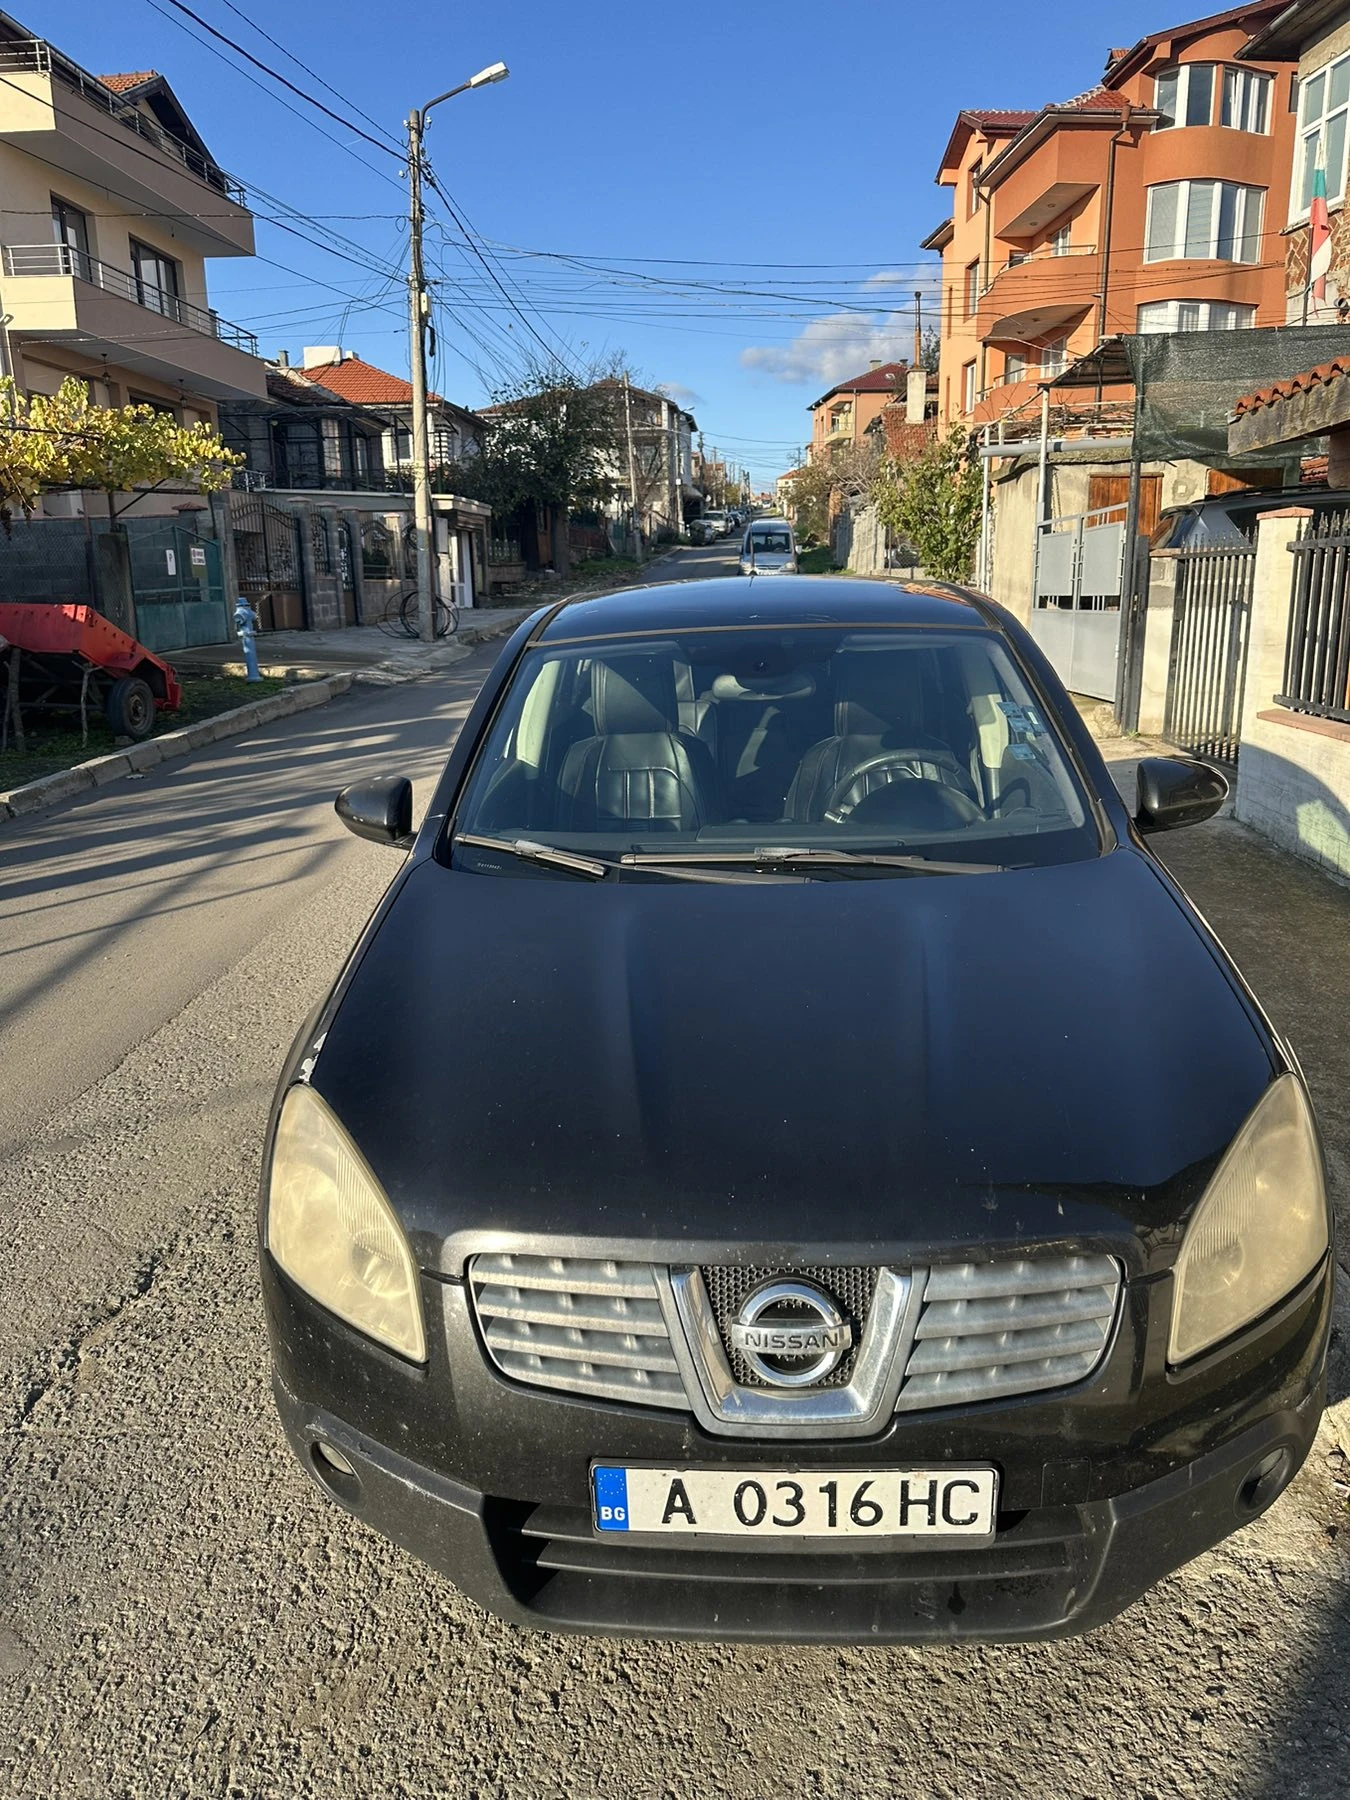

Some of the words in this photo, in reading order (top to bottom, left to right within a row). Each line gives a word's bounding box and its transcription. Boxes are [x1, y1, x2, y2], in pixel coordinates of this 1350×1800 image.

[745, 1332, 839, 1349] NISSAN
[662, 1478, 697, 1525] A
[733, 1480, 884, 1528] 0316
[899, 1479, 980, 1527] HC
[601, 1506, 626, 1522] BG
